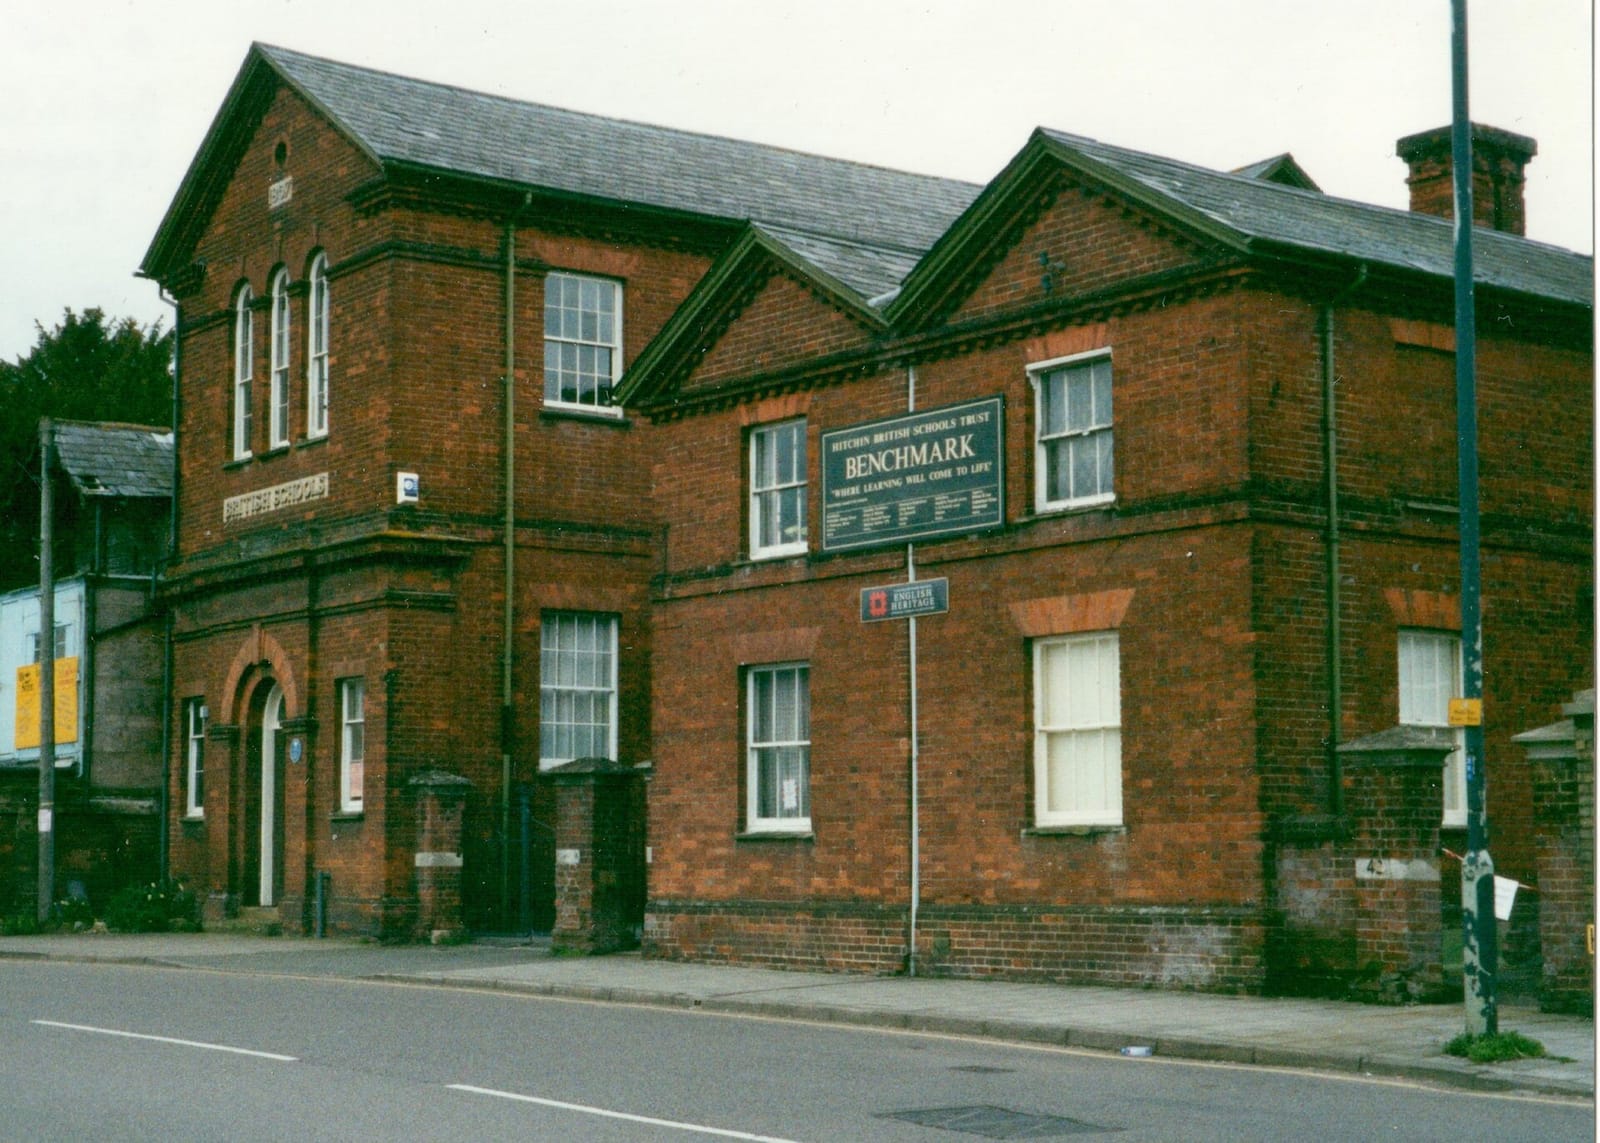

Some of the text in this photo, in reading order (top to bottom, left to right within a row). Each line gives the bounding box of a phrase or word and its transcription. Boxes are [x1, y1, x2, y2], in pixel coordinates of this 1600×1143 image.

[831, 411, 991, 452] HITCHIN BRITISH SCHOOLS TRUST
[845, 433, 976, 480] BENCHMARK
[863, 477, 904, 494] LEARNING
[905, 473, 926, 485] WILL
[928, 468, 953, 481] COME
[956, 466, 968, 476] TO
[225, 475, 326, 520] BRITISH SCHOOLS
[891, 597, 936, 611] HERITAGE
[893, 588, 933, 602] ENGLISH
